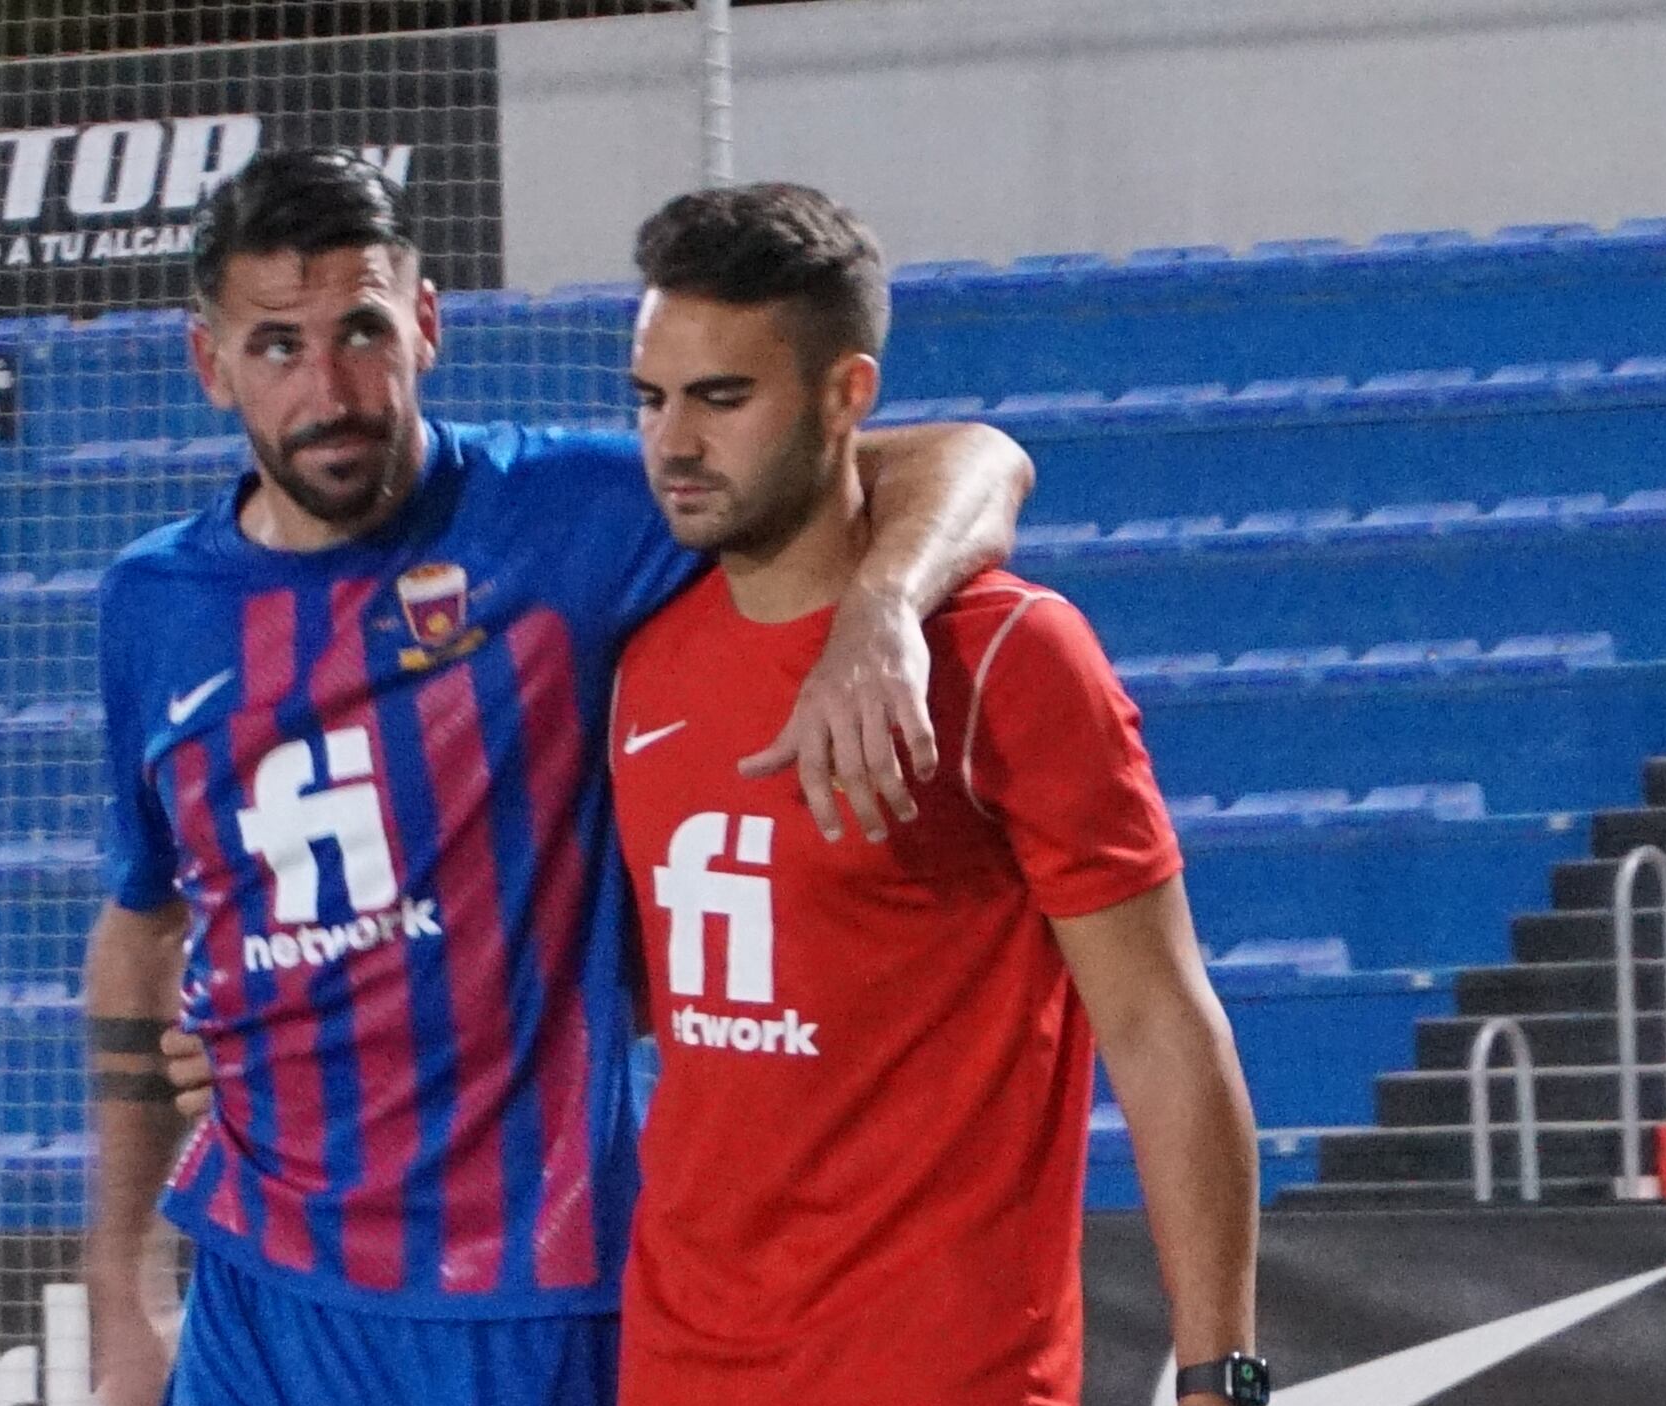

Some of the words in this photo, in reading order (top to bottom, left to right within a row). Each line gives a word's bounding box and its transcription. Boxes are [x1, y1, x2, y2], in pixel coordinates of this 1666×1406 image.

[5, 236, 32, 266] A
[39, 231, 85, 263] TU
[90, 225, 198, 259] ALCAN
[237, 725, 398, 923] fi
[243, 897, 442, 972] network
[653, 811, 775, 1003] fi
